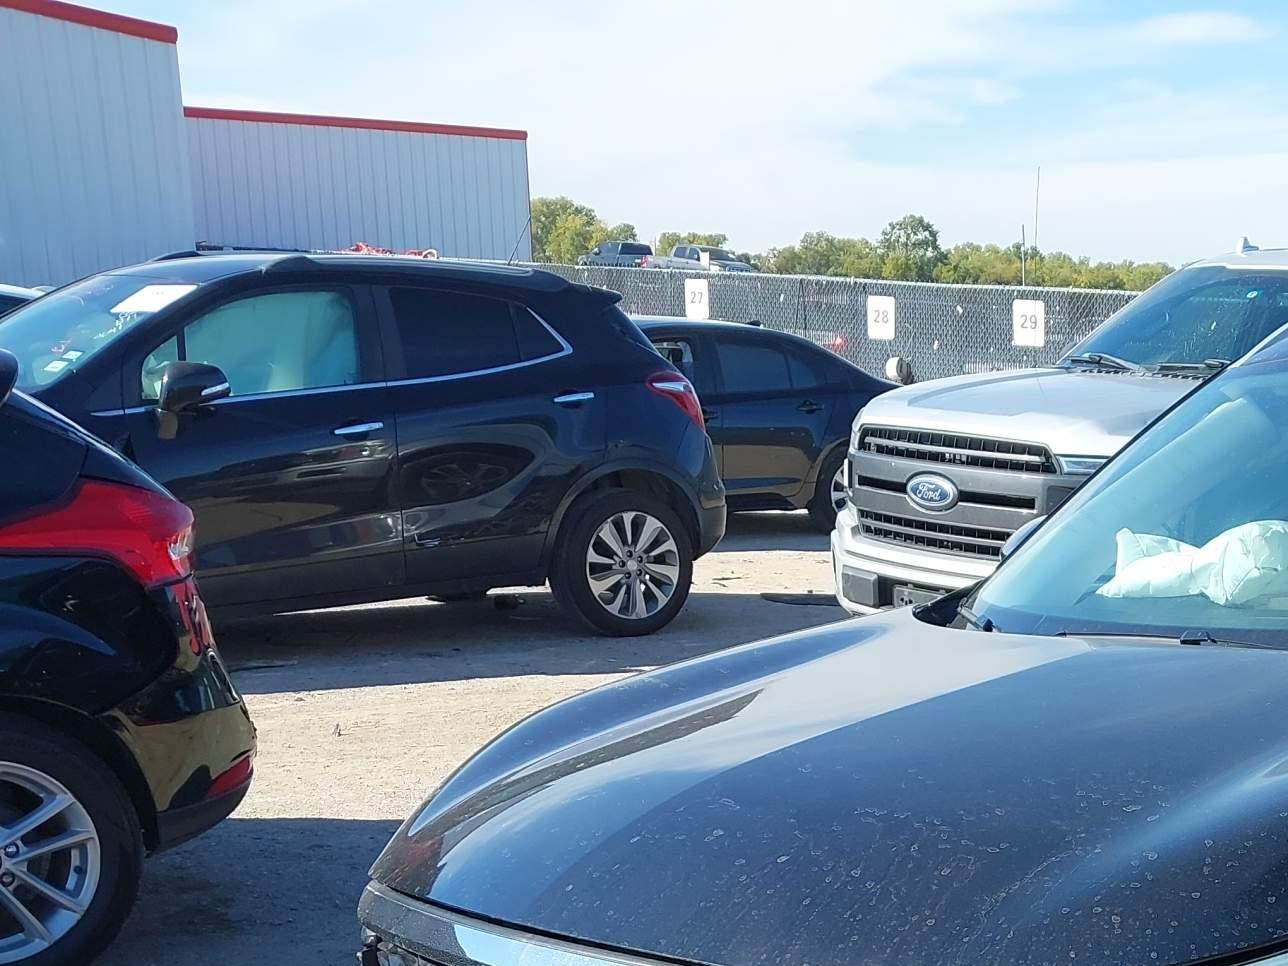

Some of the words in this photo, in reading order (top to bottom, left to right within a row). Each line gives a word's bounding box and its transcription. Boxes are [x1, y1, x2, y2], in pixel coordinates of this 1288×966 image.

[690, 291, 703, 304] 27
[873, 310, 889, 323] 28
[1020, 314, 1037, 330] 29
[916, 482, 942, 501] Ford
